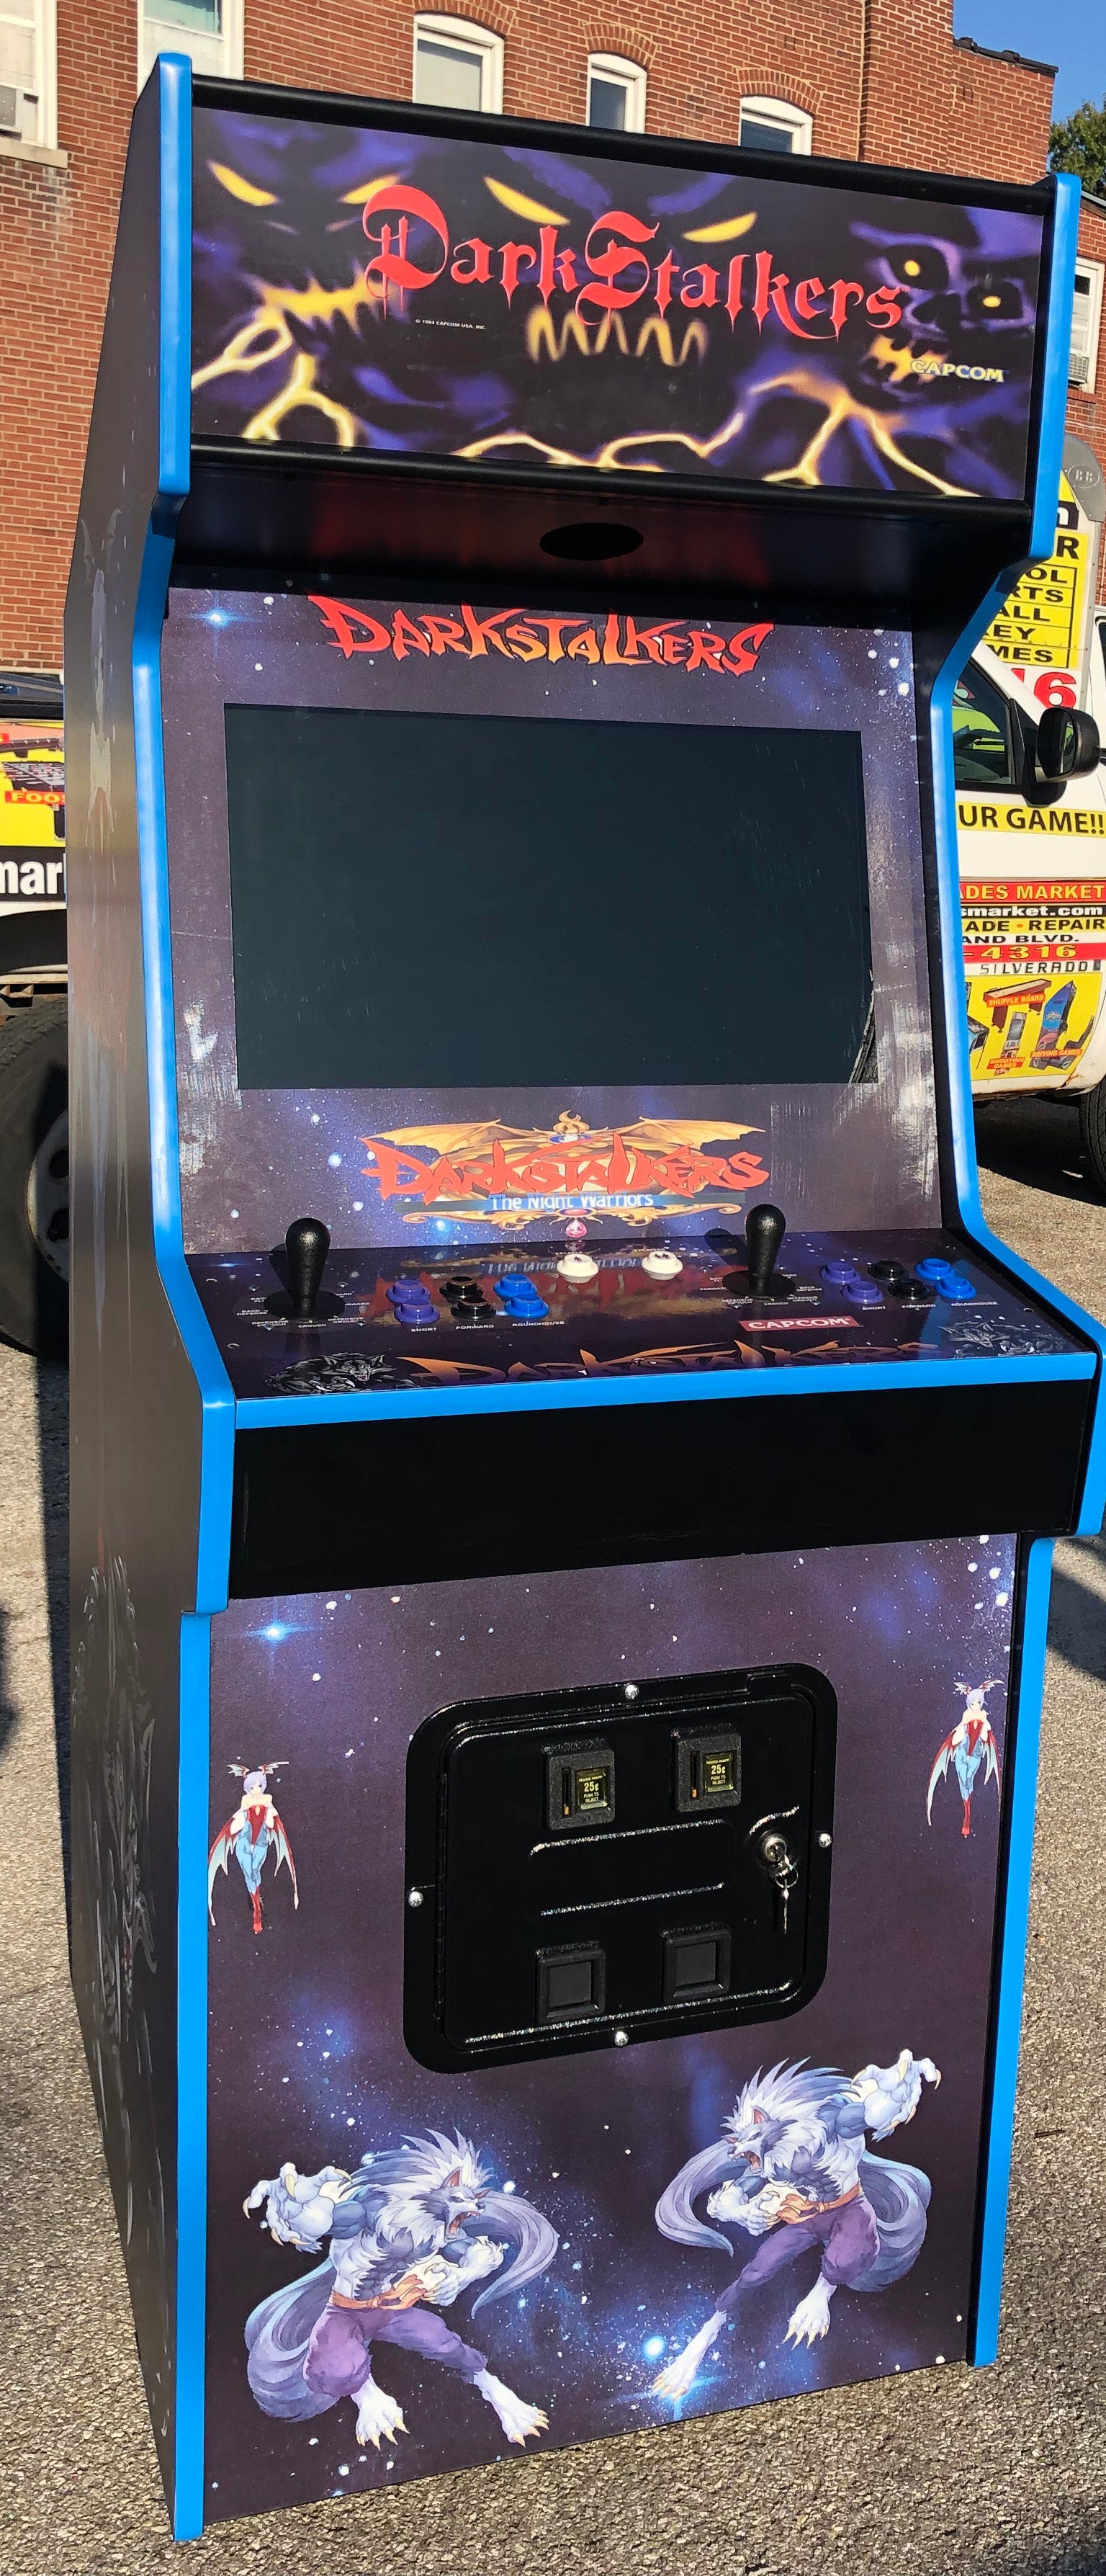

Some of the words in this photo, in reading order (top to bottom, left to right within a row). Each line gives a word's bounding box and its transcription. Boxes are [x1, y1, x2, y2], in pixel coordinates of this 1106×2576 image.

[910, 359, 1005, 383] CAPCOM
[307, 594, 774, 677] DARKSTALKERS
[985, 624, 1036, 640] EY
[958, 805, 999, 828] UR
[1006, 808, 1105, 836] GAME!!
[960, 885, 1009, 900] DES
[1016, 884, 1105, 900] MARKET
[965, 920, 1010, 932] ADE
[1028, 918, 1105, 931] REPAIR
[1015, 934, 1079, 944] BLVD.
[979, 961, 1088, 975] SILVERADO
[988, 996, 1019, 1006] SHUFFLE
[1020, 993, 1044, 1003] BOARD
[360, 1132, 770, 1206] DARKSTALKERS
[492, 1194, 524, 1211] The
[527, 1193, 575, 1212] Night
[580, 1192, 655, 1209] Warriors
[747, 1318, 850, 1330] CAPCOM
